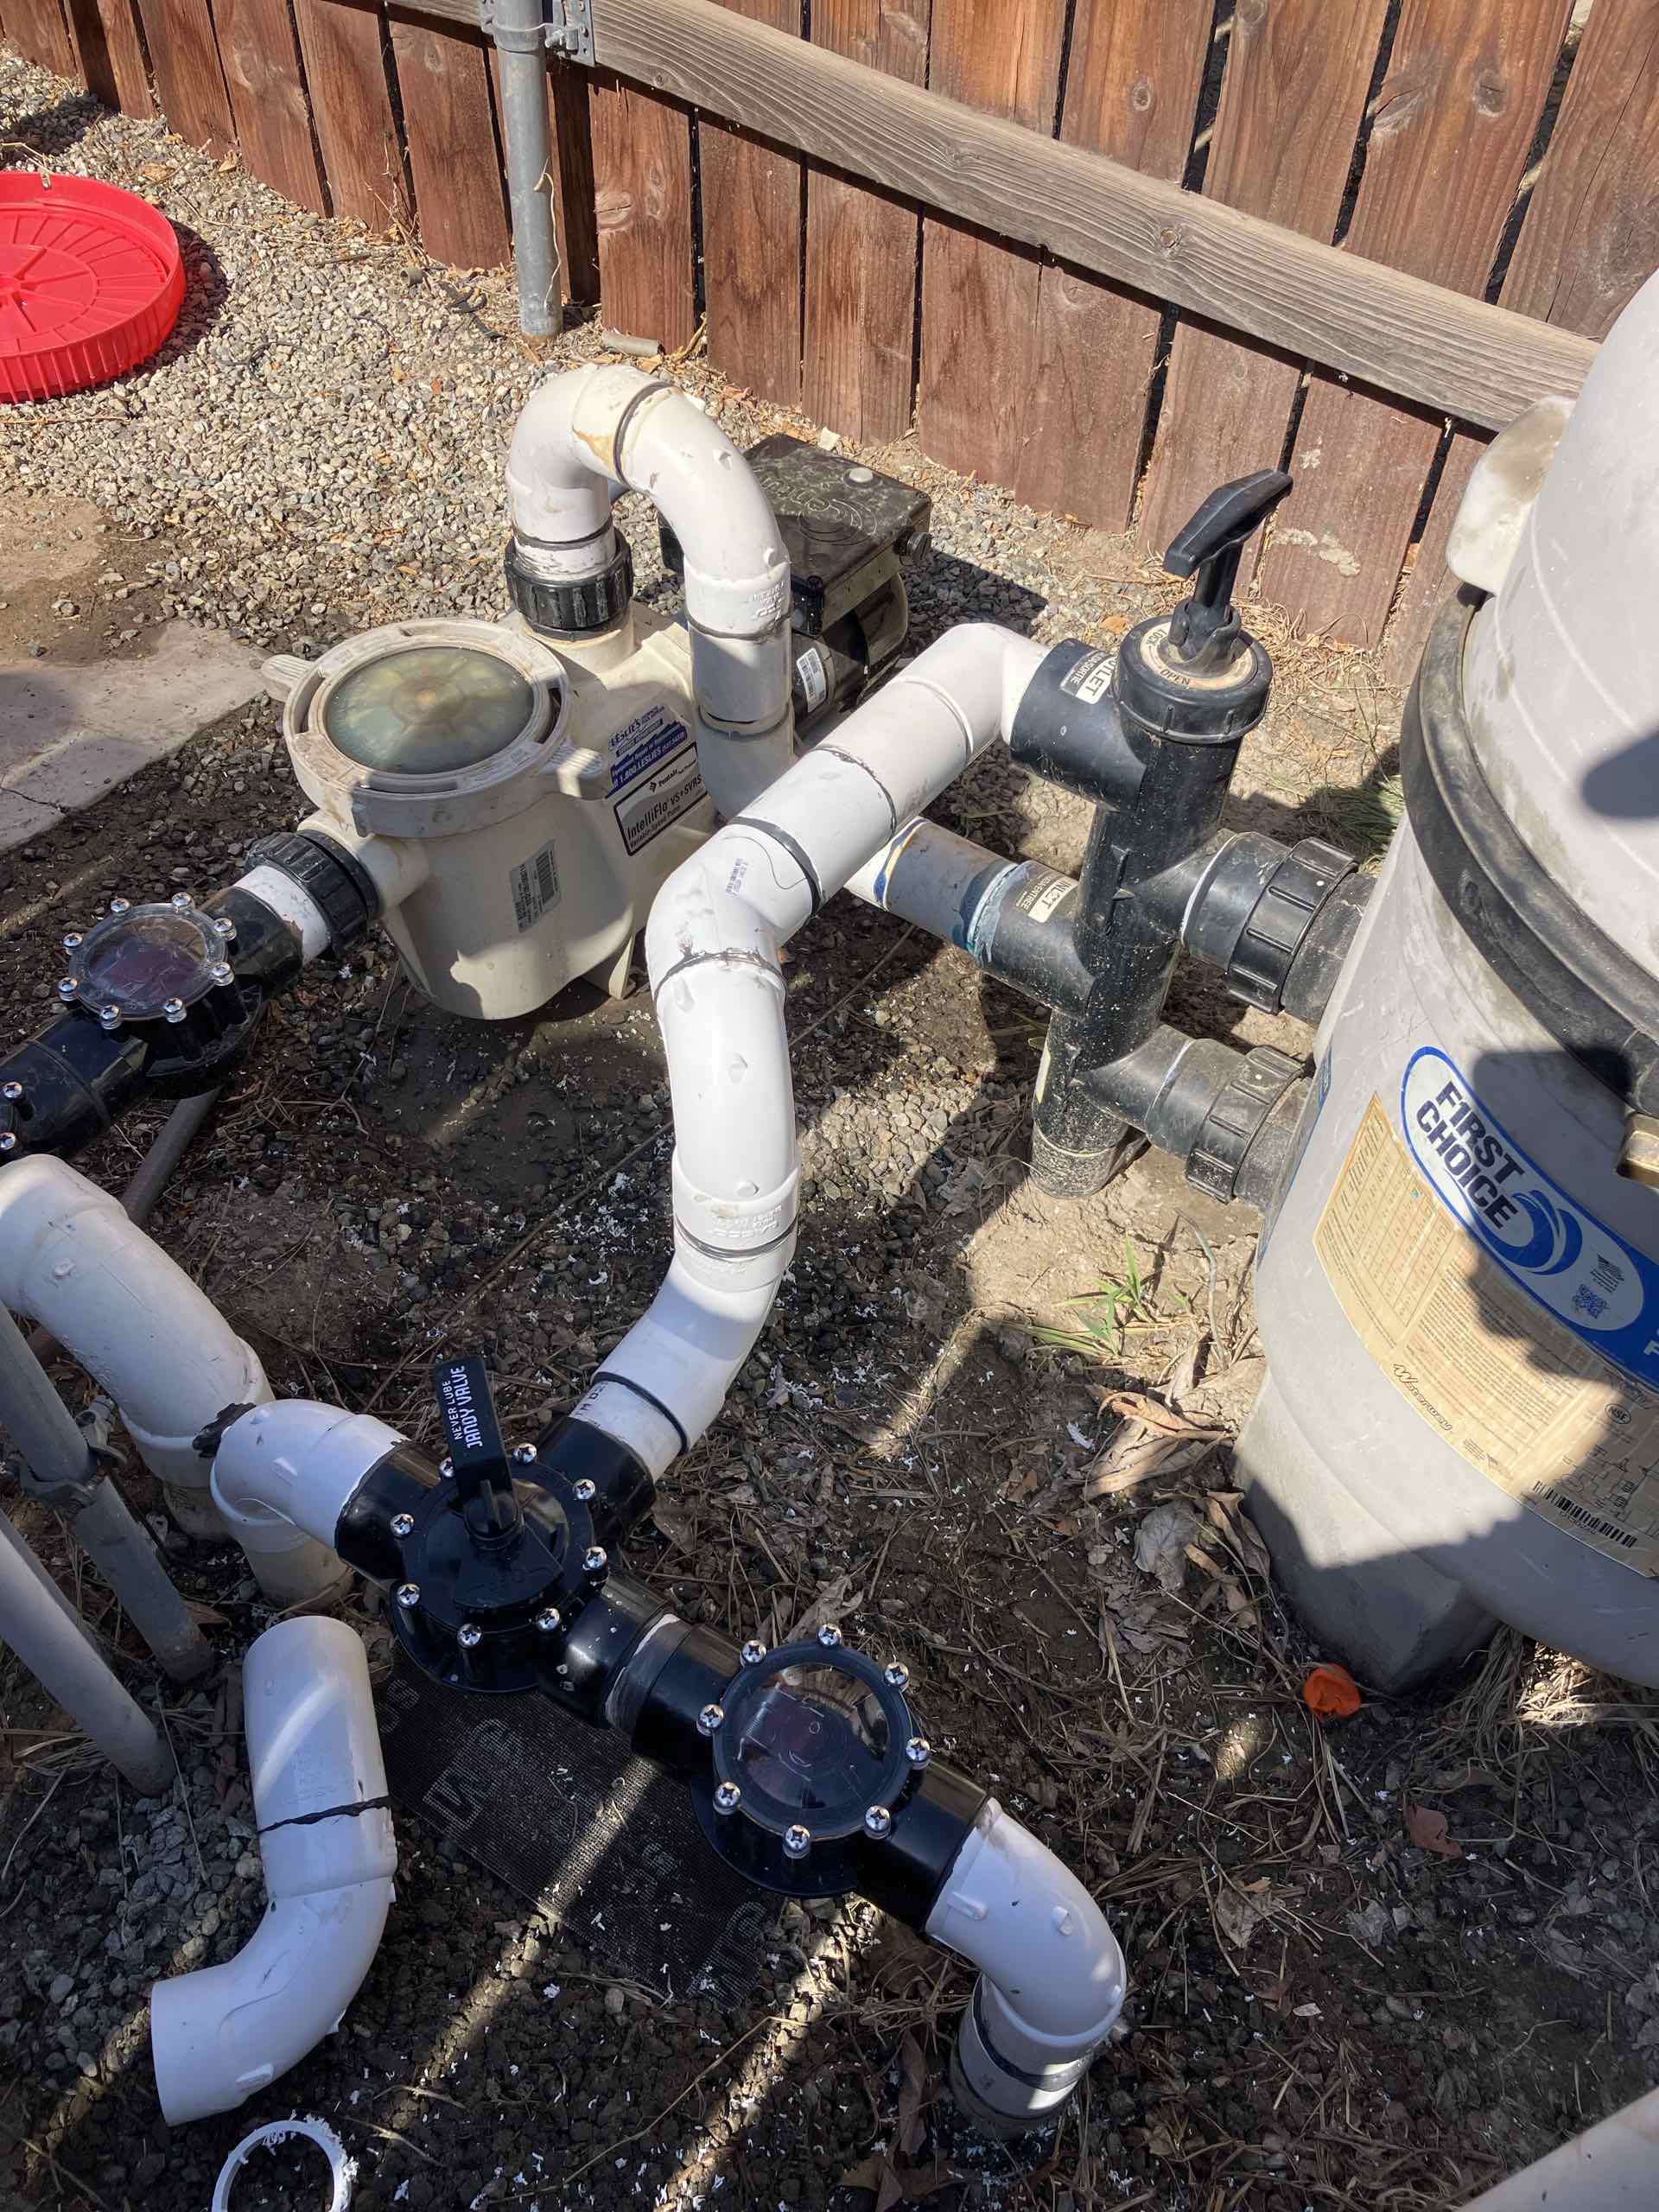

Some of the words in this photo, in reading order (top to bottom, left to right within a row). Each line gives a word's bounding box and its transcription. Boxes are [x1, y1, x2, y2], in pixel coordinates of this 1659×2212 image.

[1146, 629, 1168, 646] LOCK
[1160, 669, 1190, 685] OPEN
[658, 770, 678, 787] Pentair
[1416, 1100, 1518, 1229] CHOICE
[442, 1379, 454, 1405] LUBE
[450, 1365, 473, 1406] VALVE
[448, 1407, 464, 1440] NEVER
[459, 1408, 483, 1449] JANDY
